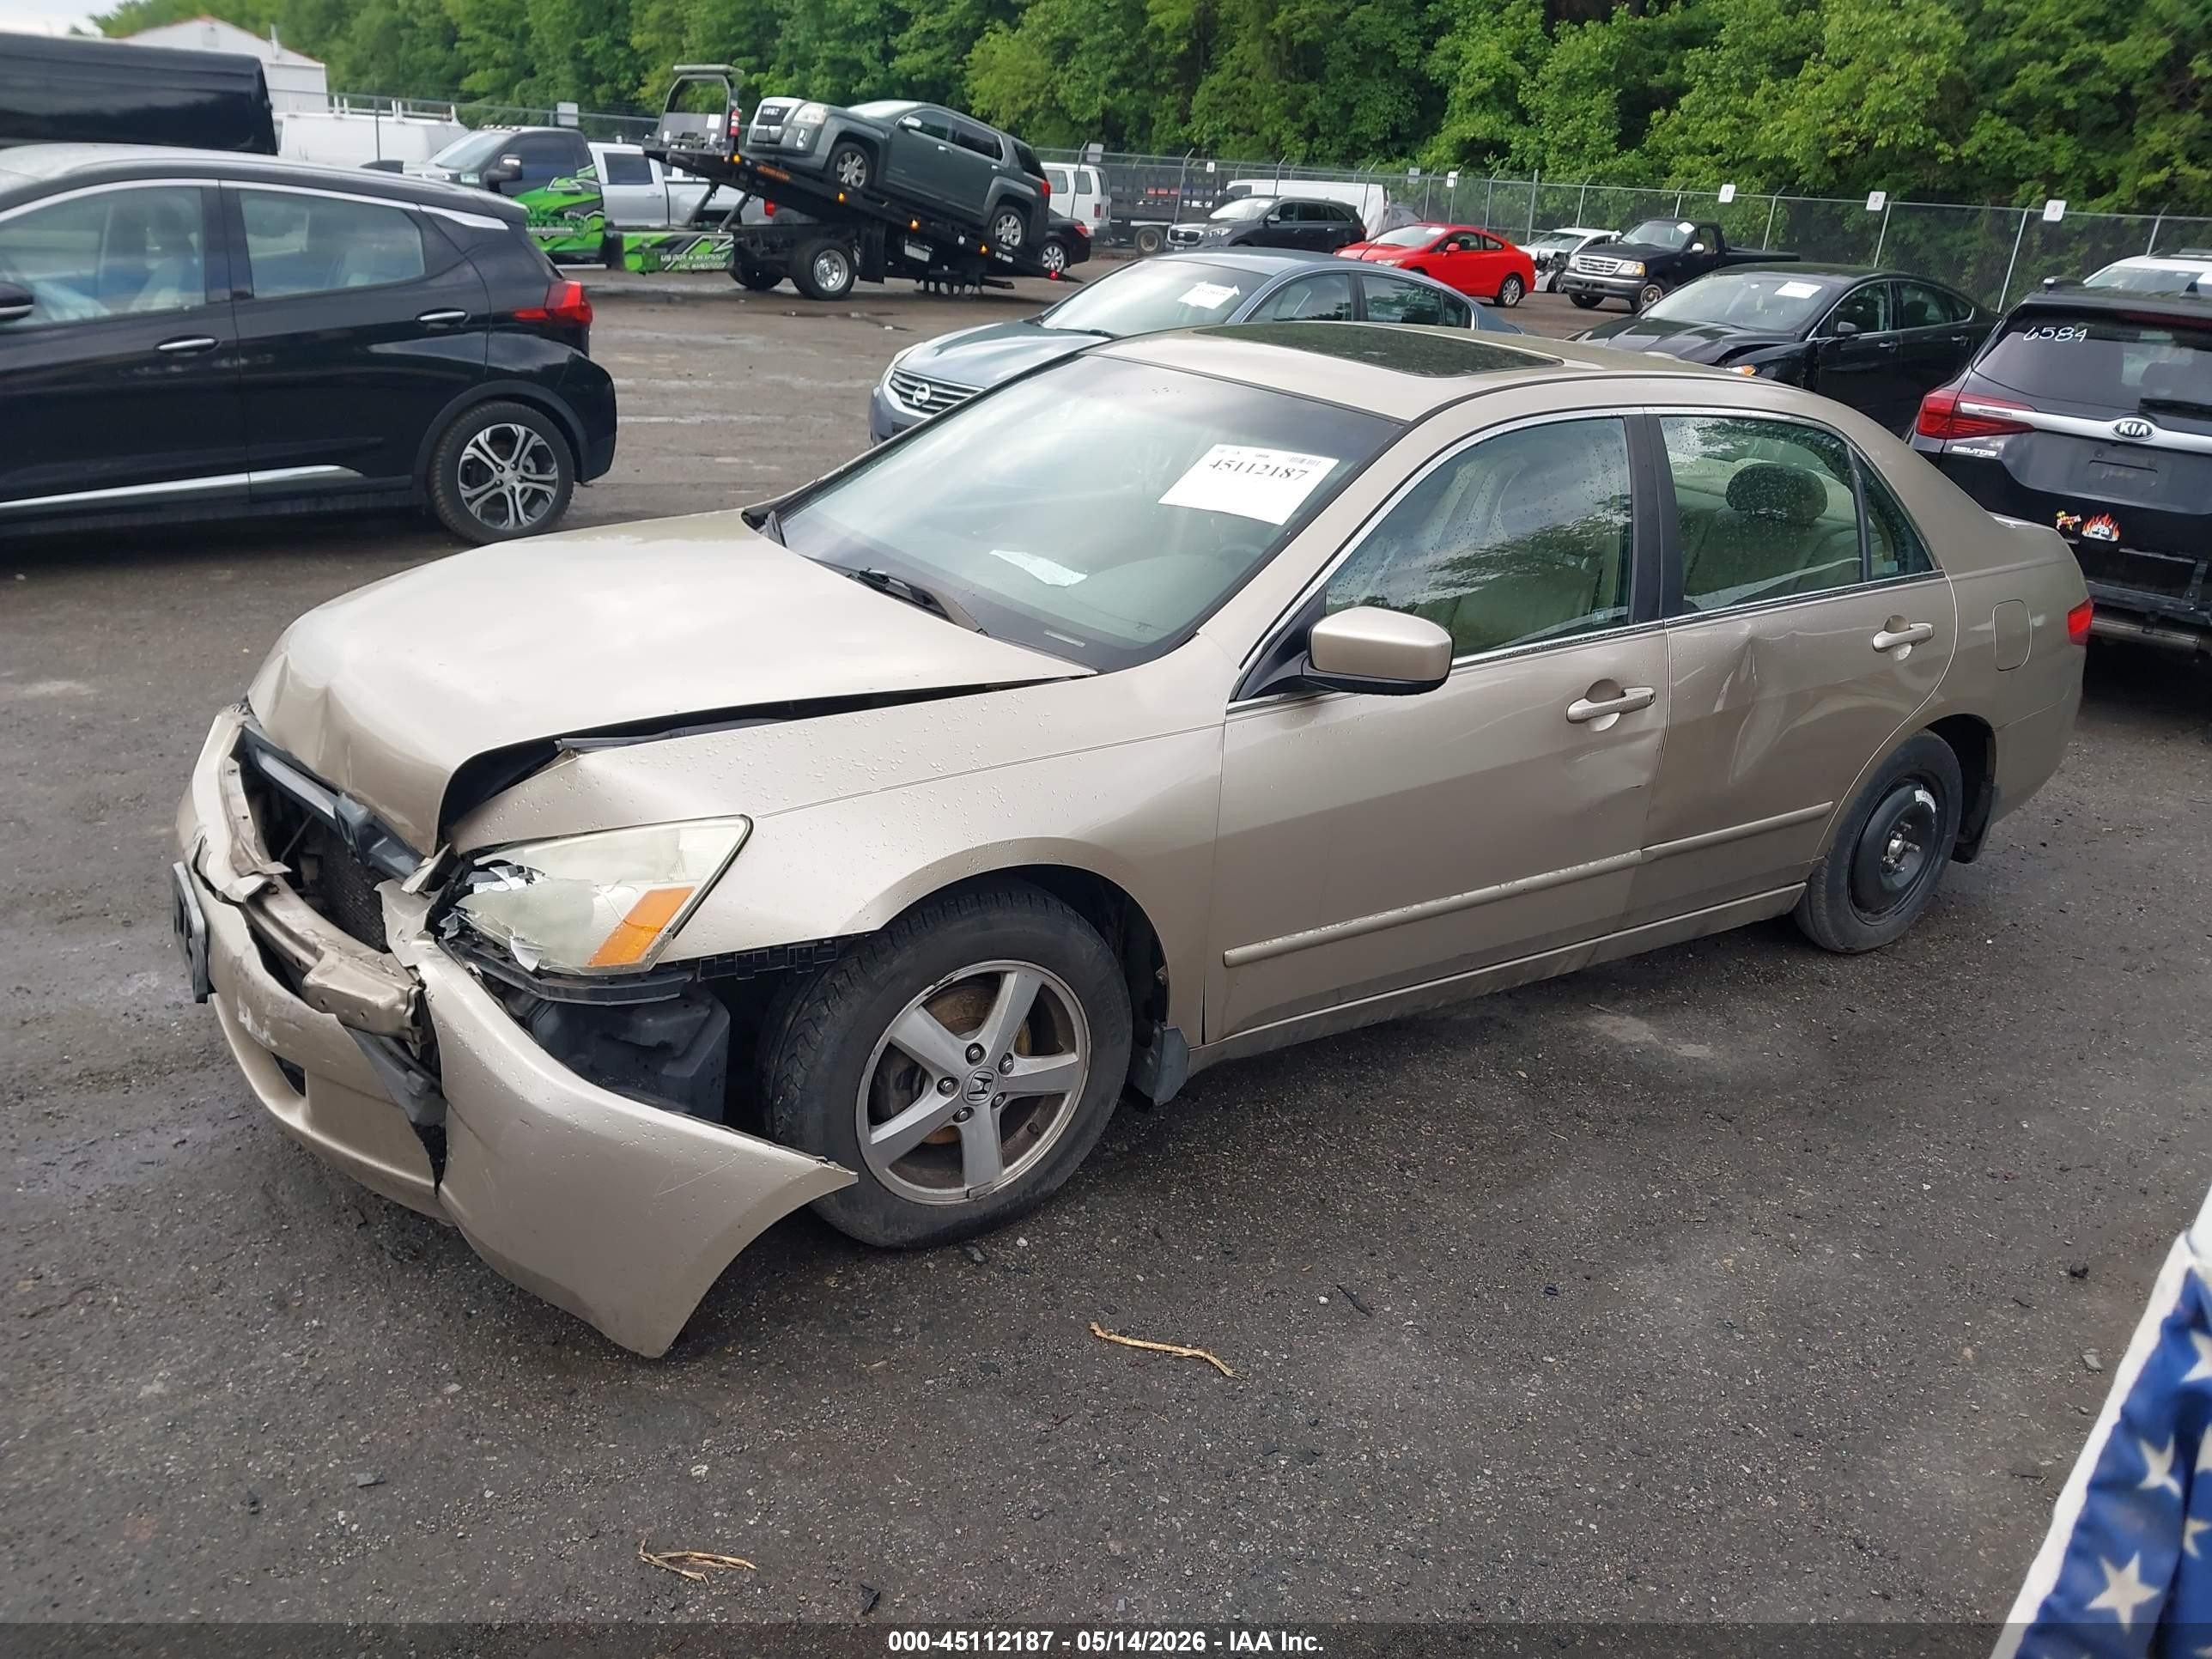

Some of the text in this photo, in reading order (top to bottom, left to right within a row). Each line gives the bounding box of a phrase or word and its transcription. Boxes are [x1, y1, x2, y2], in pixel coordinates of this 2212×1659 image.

[2023, 326, 2087, 343] 6584
[2118, 422, 2148, 436] KIA
[1209, 459, 1310, 481] 45112187
